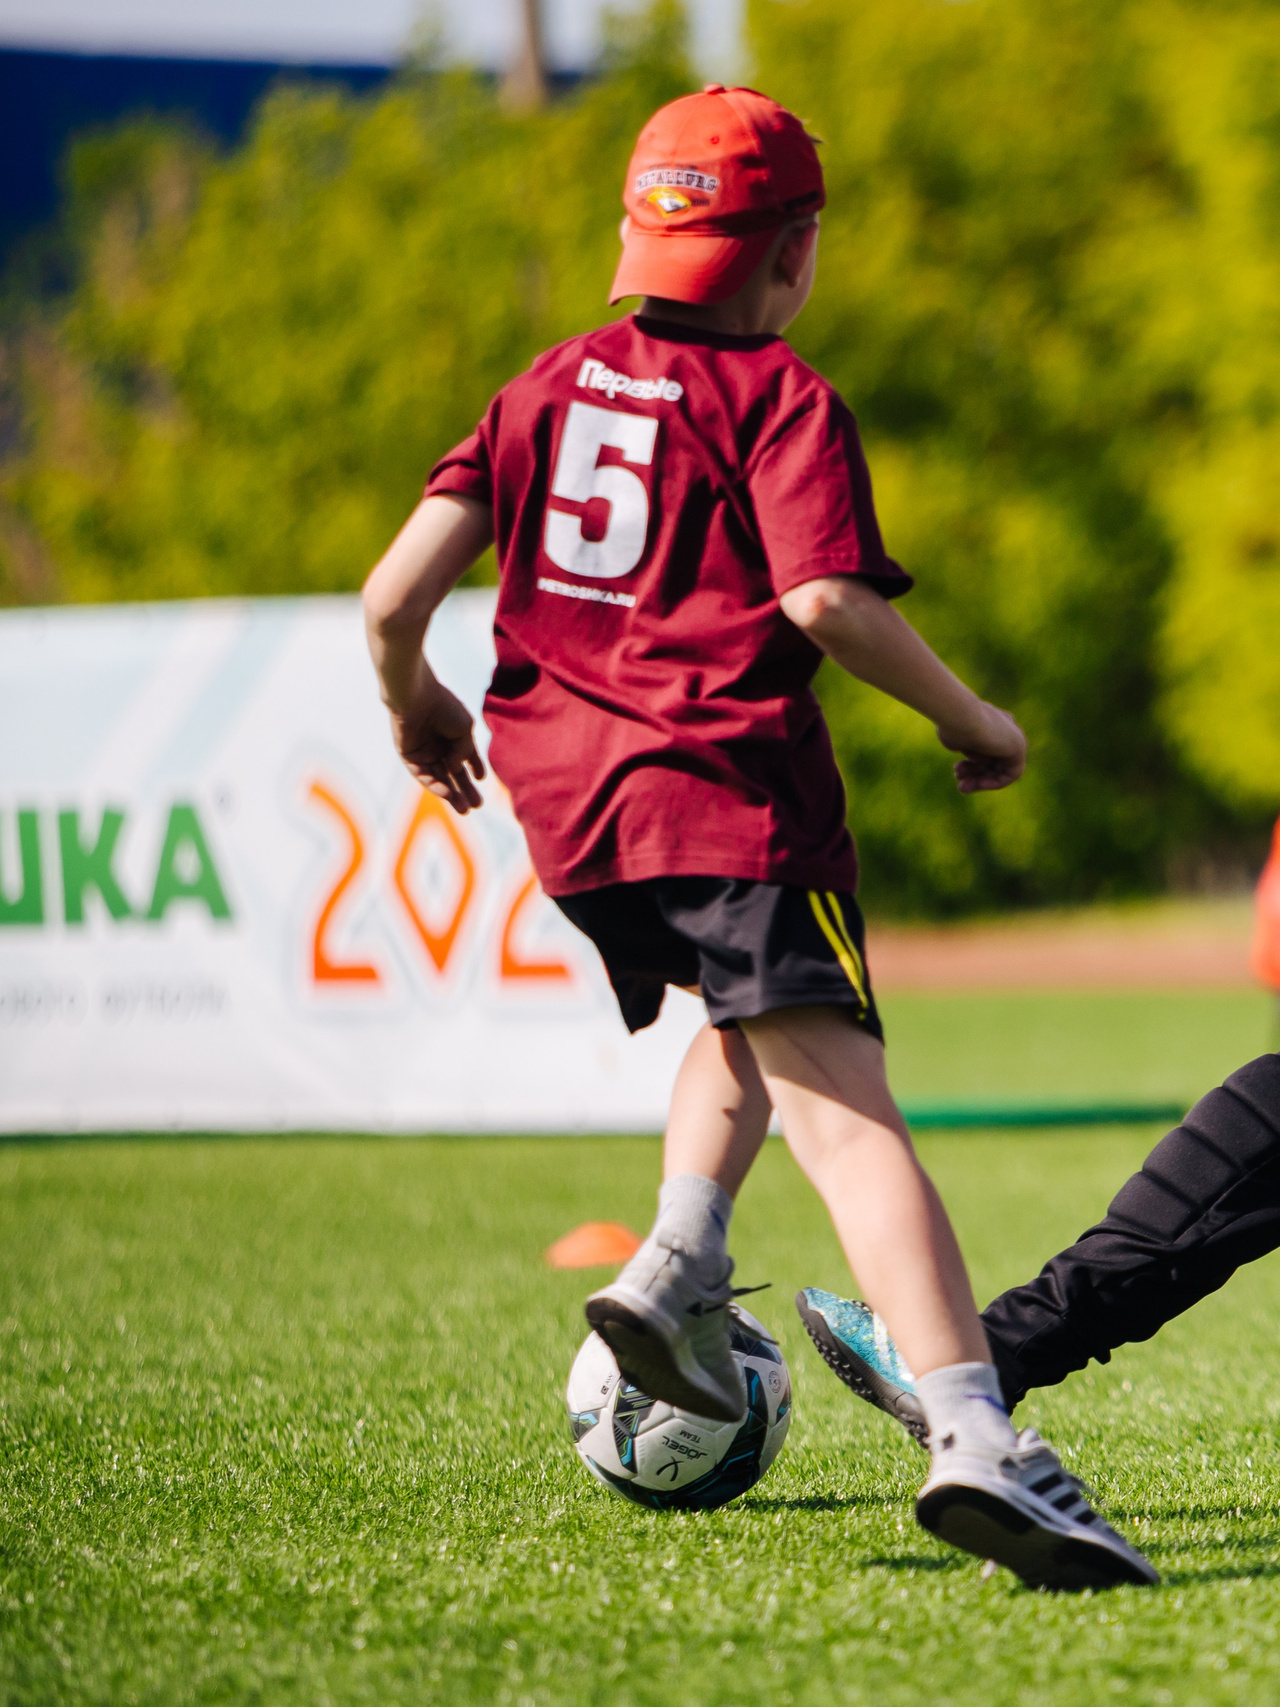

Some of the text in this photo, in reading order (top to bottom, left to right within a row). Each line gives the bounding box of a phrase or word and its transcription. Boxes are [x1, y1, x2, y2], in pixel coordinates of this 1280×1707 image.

[576, 358, 683, 401] Первые
[544, 400, 659, 579] 5
[679, 1429, 701, 1444] TEAM
